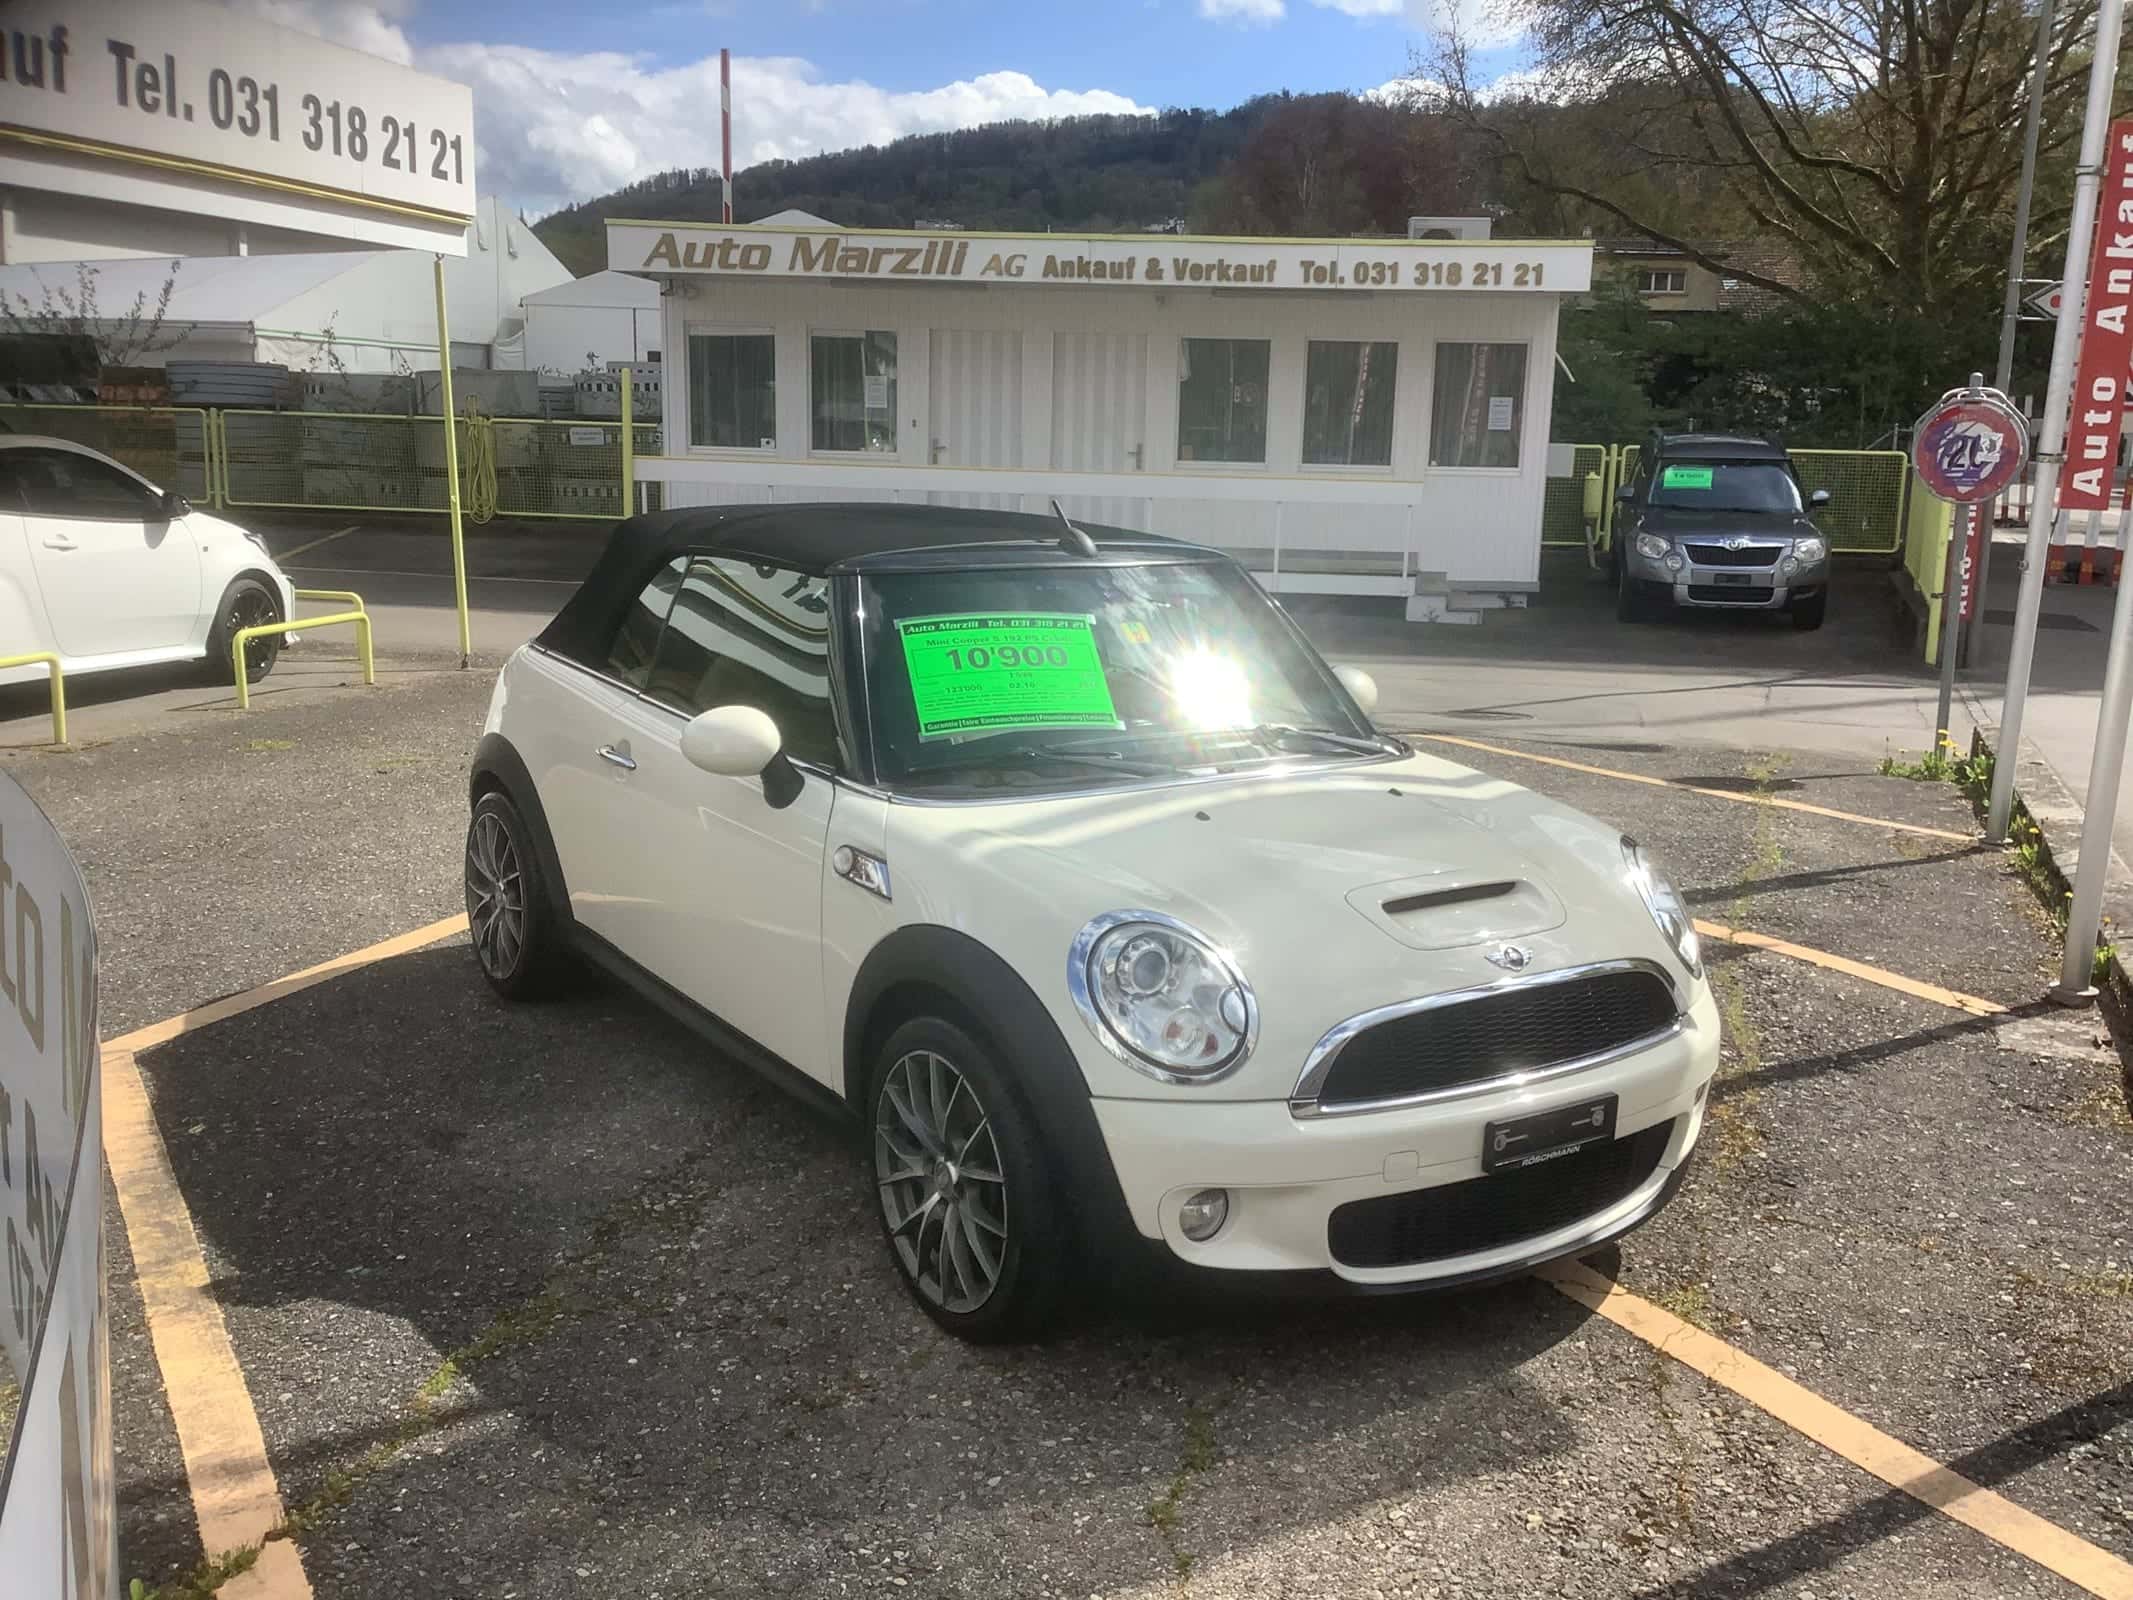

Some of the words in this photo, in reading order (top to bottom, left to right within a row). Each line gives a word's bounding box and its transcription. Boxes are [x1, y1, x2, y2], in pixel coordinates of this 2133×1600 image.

[0, 25, 71, 94] uf
[107, 39, 193, 122] Tel.
[209, 68, 281, 142] 031
[302, 94, 369, 162] 318
[381, 116, 417, 174] 21
[430, 129, 465, 185] 21
[643, 232, 772, 270] Auto
[789, 236, 968, 276] Marzili
[980, 254, 1027, 277] AG
[1042, 254, 1136, 280] Ankauf
[1145, 258, 1164, 281] &
[1173, 257, 1277, 283] Verkauf
[1301, 260, 1345, 286] Tel.
[1353, 262, 1399, 286] 031
[1414, 262, 1462, 287] 318
[1473, 263, 1502, 287] 21
[1514, 263, 1544, 287] 21
[2072, 376, 2117, 497] Auto
[907, 624, 936, 634] Auto
[988, 619, 1006, 627] Tel.
[945, 646, 1068, 672] 10'900
